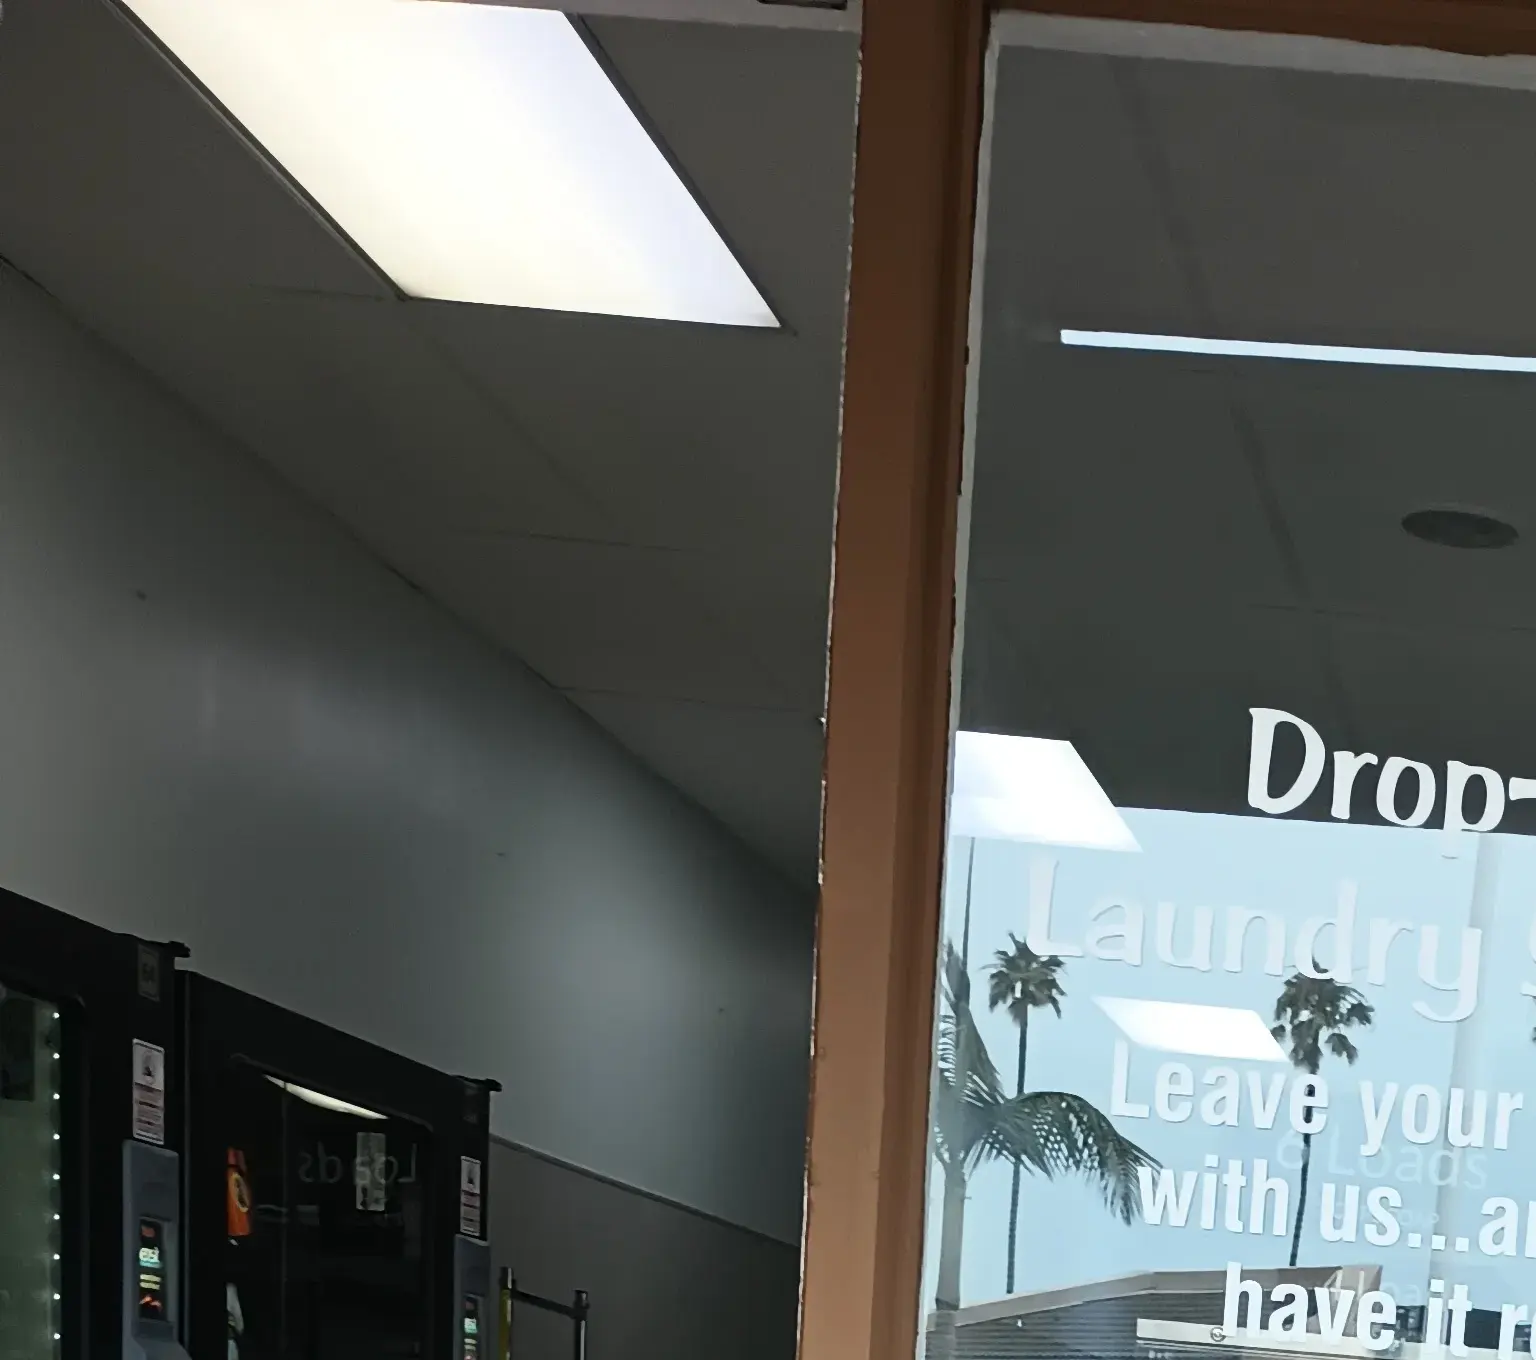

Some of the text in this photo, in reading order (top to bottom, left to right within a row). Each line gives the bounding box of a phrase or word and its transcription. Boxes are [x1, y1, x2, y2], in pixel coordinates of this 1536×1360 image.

[1025, 860, 1483, 1021] Laundry
[1110, 1038, 1328, 1134] Leave
[1360, 1078, 1523, 1156] your
[1138, 1154, 1289, 1238] with
[1222, 1263, 1398, 1350] have
[1422, 1279, 1473, 1358] it
